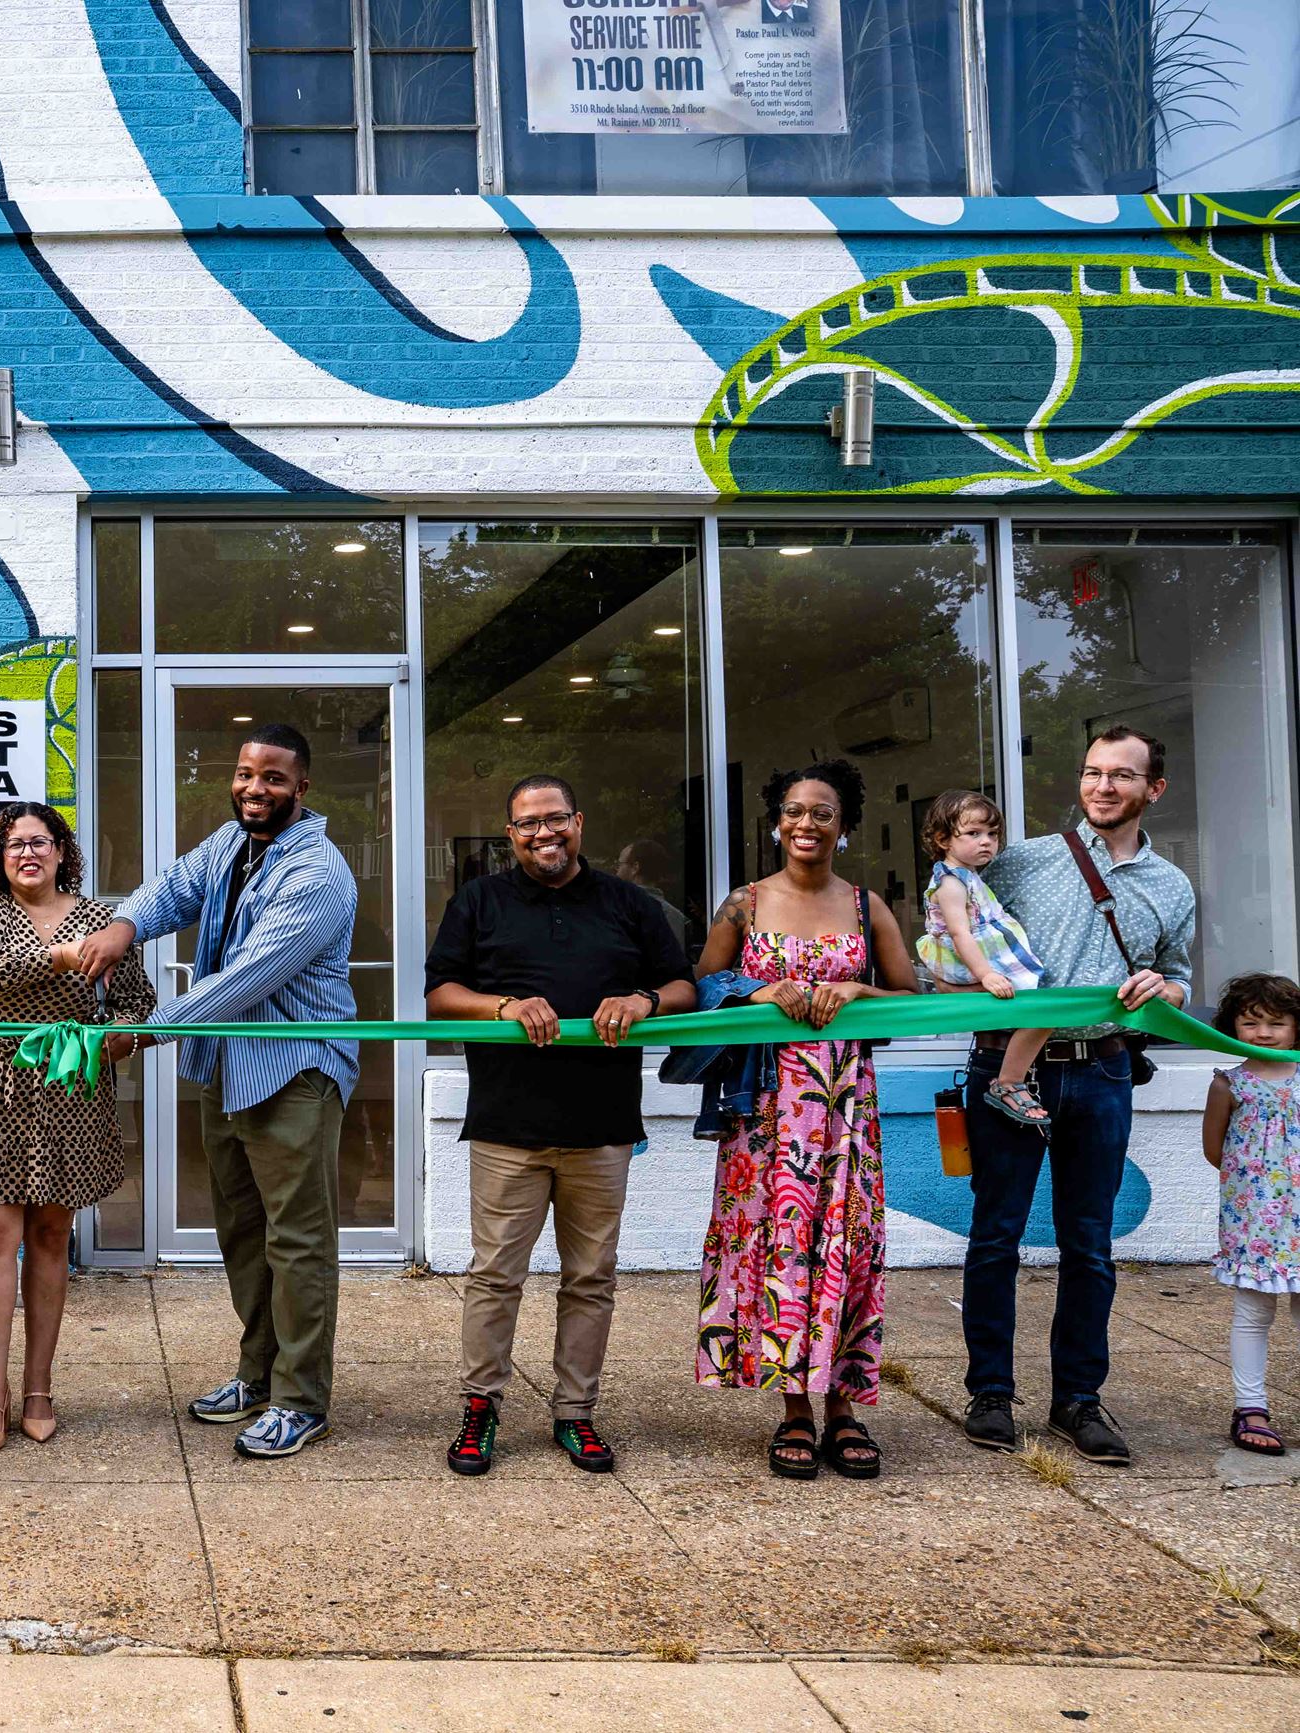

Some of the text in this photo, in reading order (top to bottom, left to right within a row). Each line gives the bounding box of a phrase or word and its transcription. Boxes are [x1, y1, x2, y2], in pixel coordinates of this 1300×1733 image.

[569, 15, 702, 50] SERVICE TIME
[735, 28, 759, 38] Pastor
[761, 28, 780, 37] Paul
[790, 27, 815, 37] Wood
[744, 51, 765, 59] Come
[766, 51, 780, 60] join
[757, 60, 811, 69] Sunday and be
[572, 56, 704, 92] 11:00 AM
[735, 70, 770, 78] refreshed
[746, 80, 769, 88] Pastor
[771, 79, 787, 87] Paul
[733, 90, 752, 98] deep
[784, 89, 803, 97] Word
[804, 89, 813, 97] of
[750, 99, 813, 107] God with wisdom,
[570, 104, 588, 113] 3510
[590, 104, 614, 113] Rhode
[616, 104, 638, 114] Island
[671, 104, 685, 113] 2nd
[687, 104, 706, 113] floor
[756, 109, 813, 118] knowledge, and
[596, 118, 609, 127] Mt.
[642, 118, 656, 127] MD
[658, 118, 681, 127] 20712
[778, 119, 814, 127] revelation
